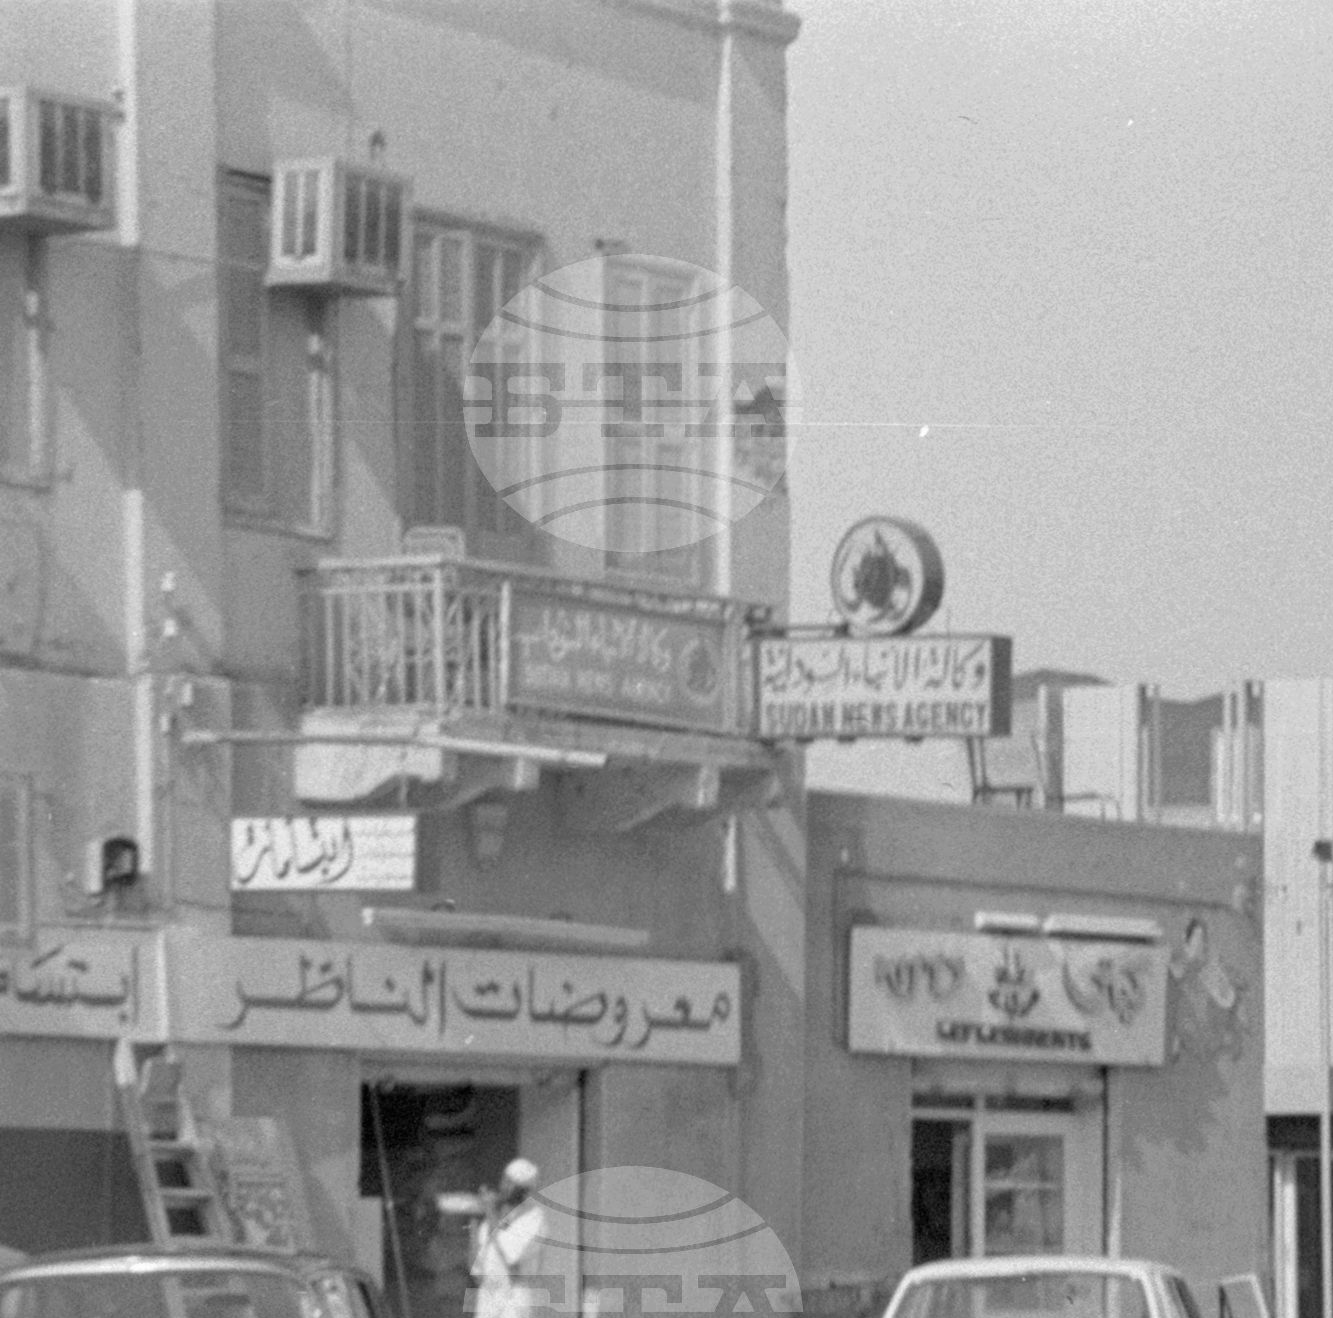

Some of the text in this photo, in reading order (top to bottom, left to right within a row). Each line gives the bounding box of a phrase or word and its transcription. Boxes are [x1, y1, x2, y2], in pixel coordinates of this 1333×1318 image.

[764, 701, 837, 732] SUDAN
[903, 701, 986, 731] AGENCY
[216, 950, 732, 1050] معروضات الناظر
